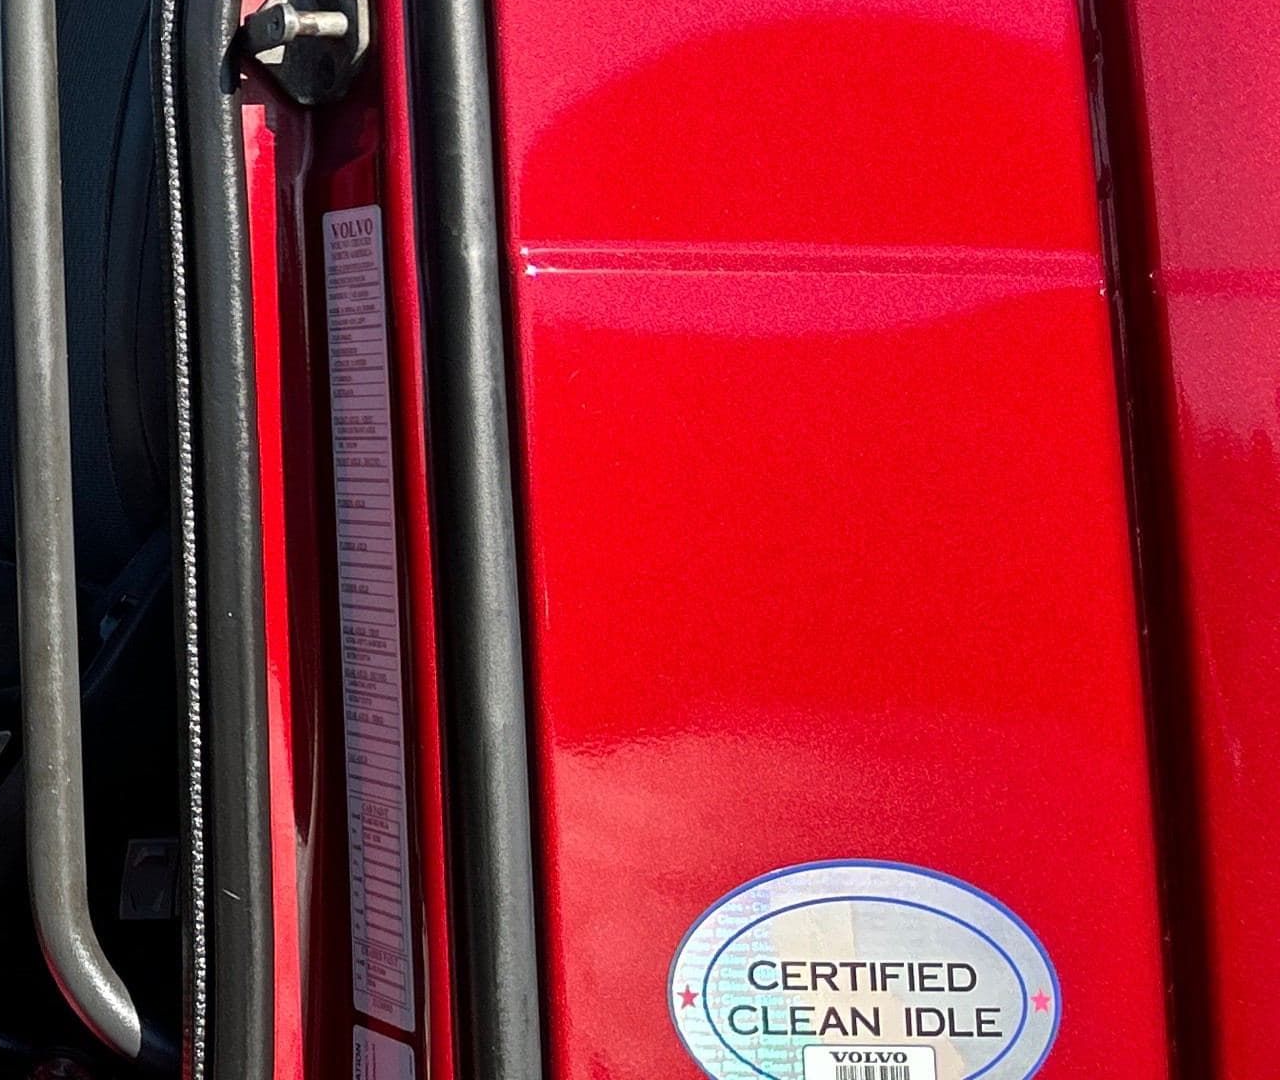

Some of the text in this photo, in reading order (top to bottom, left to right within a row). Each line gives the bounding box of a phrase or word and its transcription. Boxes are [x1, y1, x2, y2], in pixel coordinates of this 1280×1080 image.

[331, 219, 373, 239] VOLVO
[747, 960, 977, 992] CERTIFIED
[728, 1004, 1003, 1038] CLEAN IDLE
[829, 1050, 908, 1065] VOLVO
